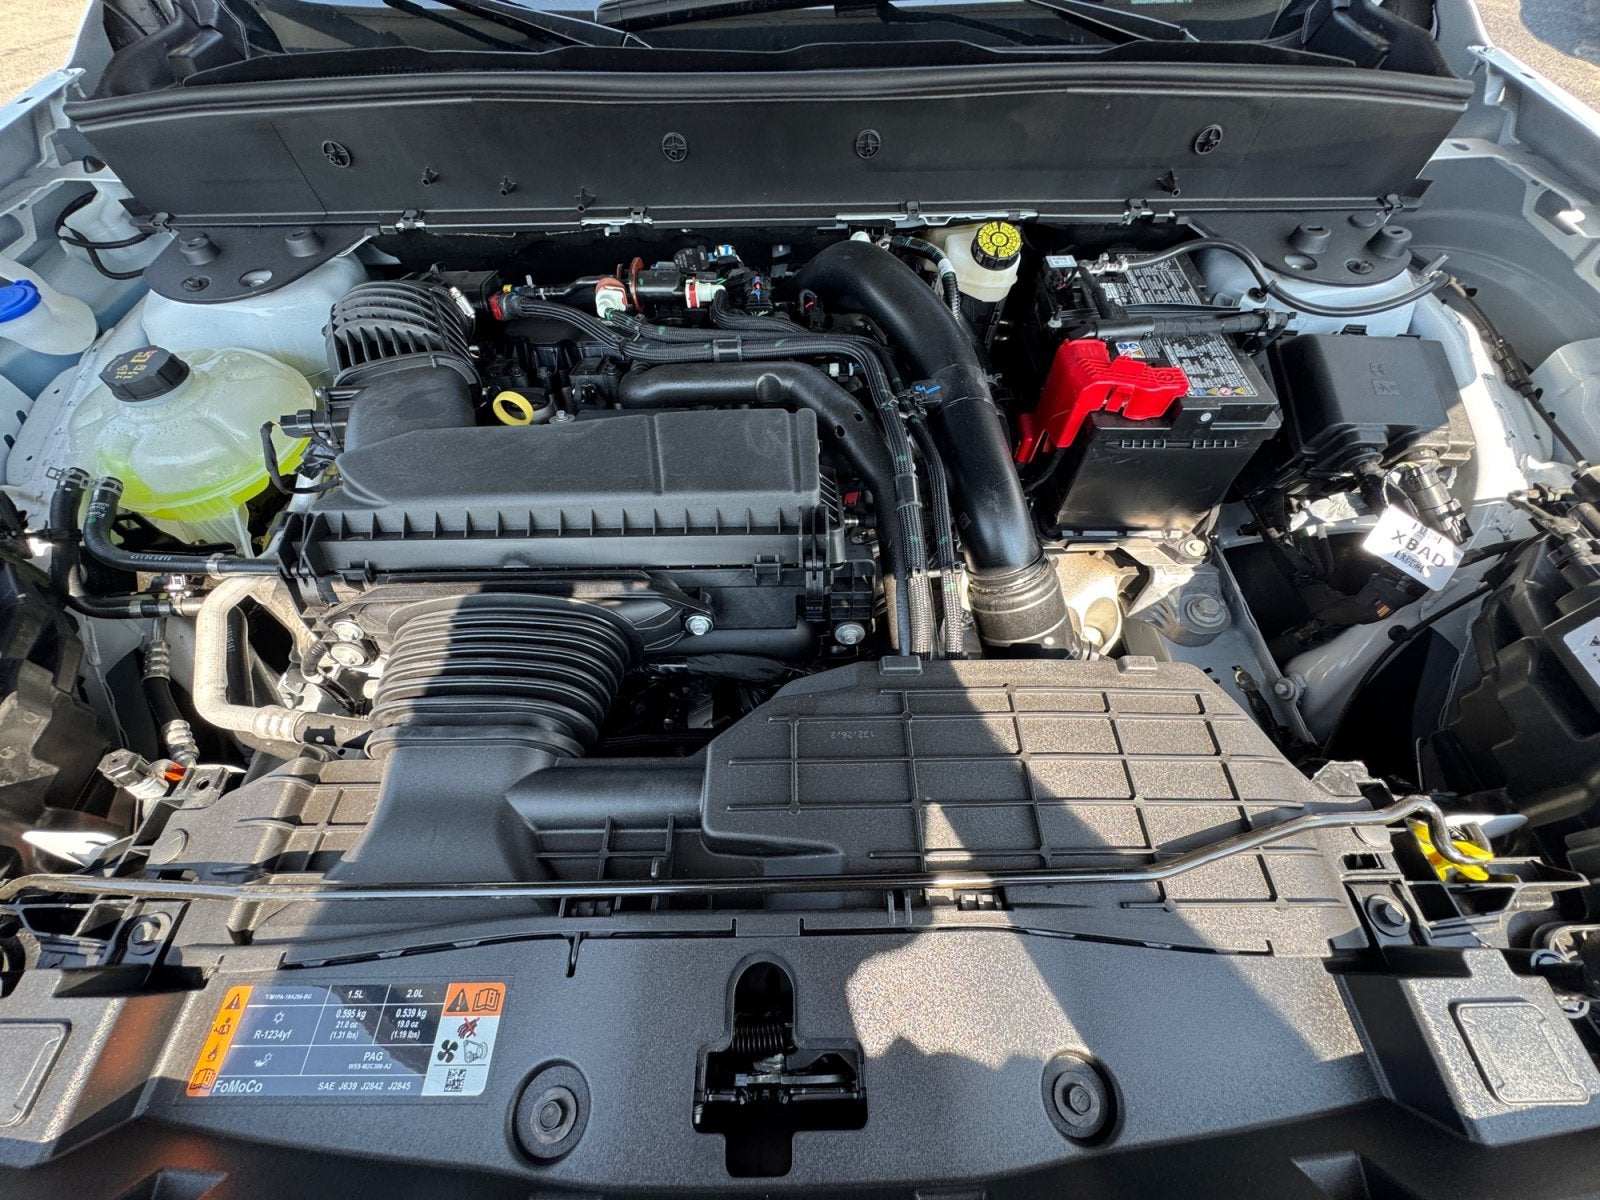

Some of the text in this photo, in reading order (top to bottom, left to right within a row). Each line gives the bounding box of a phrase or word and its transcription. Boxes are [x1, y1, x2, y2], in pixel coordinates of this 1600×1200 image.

[1391, 530, 1446, 568] XBAD
[347, 990, 364, 998] 1.5L
[406, 989, 423, 998] 2.0L
[336, 1009, 367, 1020] 0.595 kg
[395, 1008, 427, 1020] 0.539 kg
[253, 1029, 293, 1042] R-1234yf
[330, 1031, 359, 1040] (1.31 lbs)
[390, 1030, 420, 1040] (1.19 lbs)
[363, 1052, 384, 1061] PAG
[212, 1079, 263, 1093] FoMoCo
[318, 1081, 411, 1090] SAE J639 J2842 J2845
